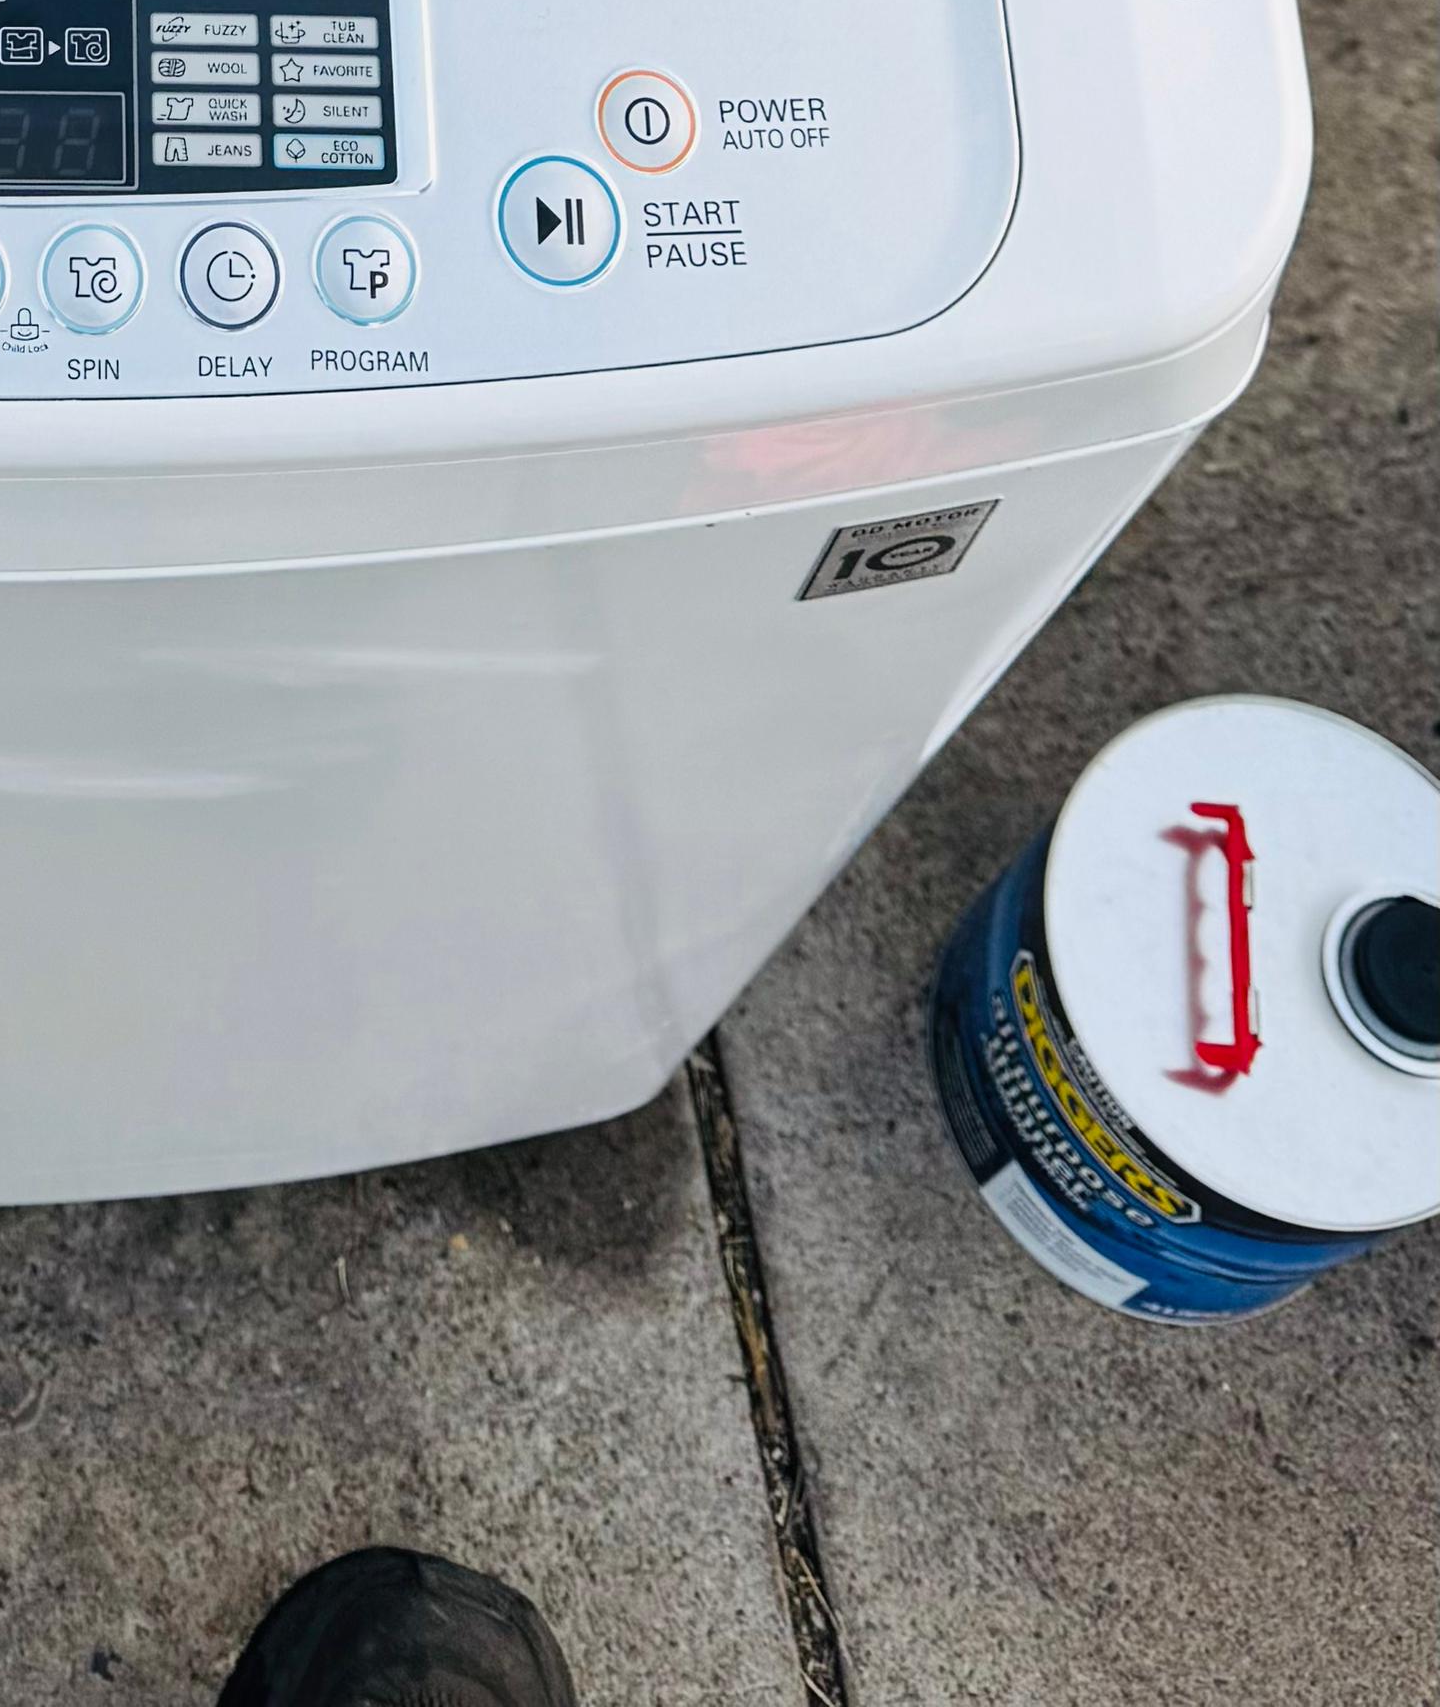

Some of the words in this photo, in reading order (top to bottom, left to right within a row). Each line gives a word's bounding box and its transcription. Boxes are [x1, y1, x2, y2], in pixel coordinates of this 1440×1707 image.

[205, 25, 247, 36] FUZZY
[331, 21, 355, 31] TUB
[323, 33, 364, 44] CLEAN
[208, 63, 247, 74] WOOL
[313, 65, 373, 78] FAVORITE
[208, 98, 248, 110] QUICK
[210, 111, 248, 122] WASH
[323, 105, 369, 117] SILENT
[719, 98, 827, 123] POWER
[723, 129, 784, 150] AUTO
[790, 127, 830, 148] OFF
[208, 145, 252, 157] JEANS
[333, 140, 358, 151] ECO
[322, 152, 374, 164] COTTON
[643, 200, 740, 227] START
[647, 242, 747, 268] PAUSE
[198, 356, 273, 377] DELAY
[311, 350, 429, 372] PROGRAM
[68, 359, 120, 380] SPIN
[1013, 964, 1185, 1217] DIGGERS
